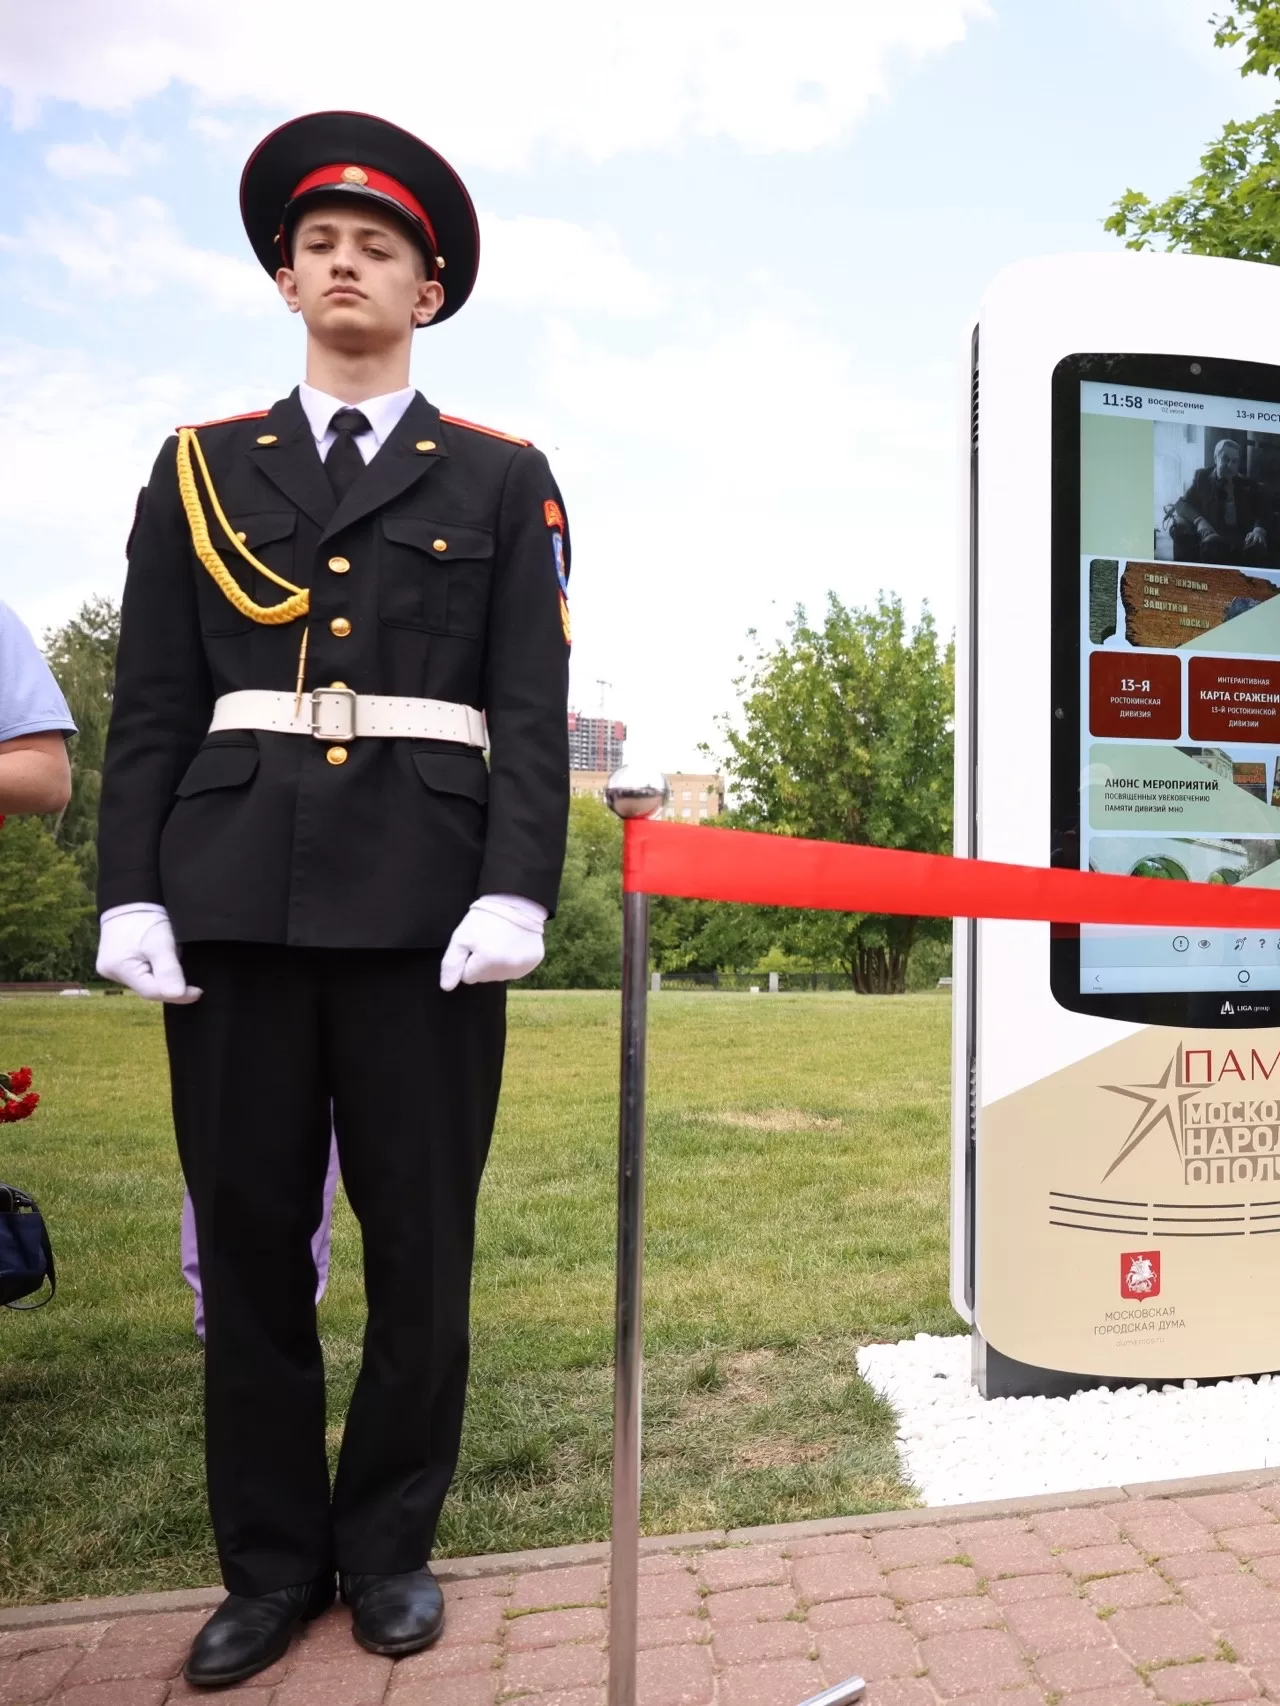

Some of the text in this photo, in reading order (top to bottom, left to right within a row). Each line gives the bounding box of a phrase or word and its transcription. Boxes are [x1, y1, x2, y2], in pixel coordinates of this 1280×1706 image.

[1102, 392, 1204, 410] 11:58 воскресение
[1236, 410, 1255, 420] 13-я
[1121, 678, 1150, 692] 13-Я
[1217, 676, 1270, 685] ИНТЕРАКТИВНАЯ
[1110, 696, 1161, 705] РОСТОКИНСКАЯ
[1200, 690, 1231, 701] КАРТА
[1120, 710, 1151, 718] ДИВИЗИЯ
[1227, 706, 1276, 716] РОСТОКИНСКОЙ
[1229, 719, 1259, 727] ДИВИЗИИ
[1104, 778, 1140, 789] АНОНС
[1104, 792, 1210, 802] ПОСВЯЩЕННЫХ УВЕКОВЕЧЕНИЮ
[1104, 804, 1133, 812] ПАМЯТИ
[1134, 804, 1166, 813] ДИВИЗИЙ
[1104, 1306, 1176, 1321] МОСКОВСКАЯ
[1094, 1319, 1186, 1336] ГОРОДСКАЯ ДУМА
